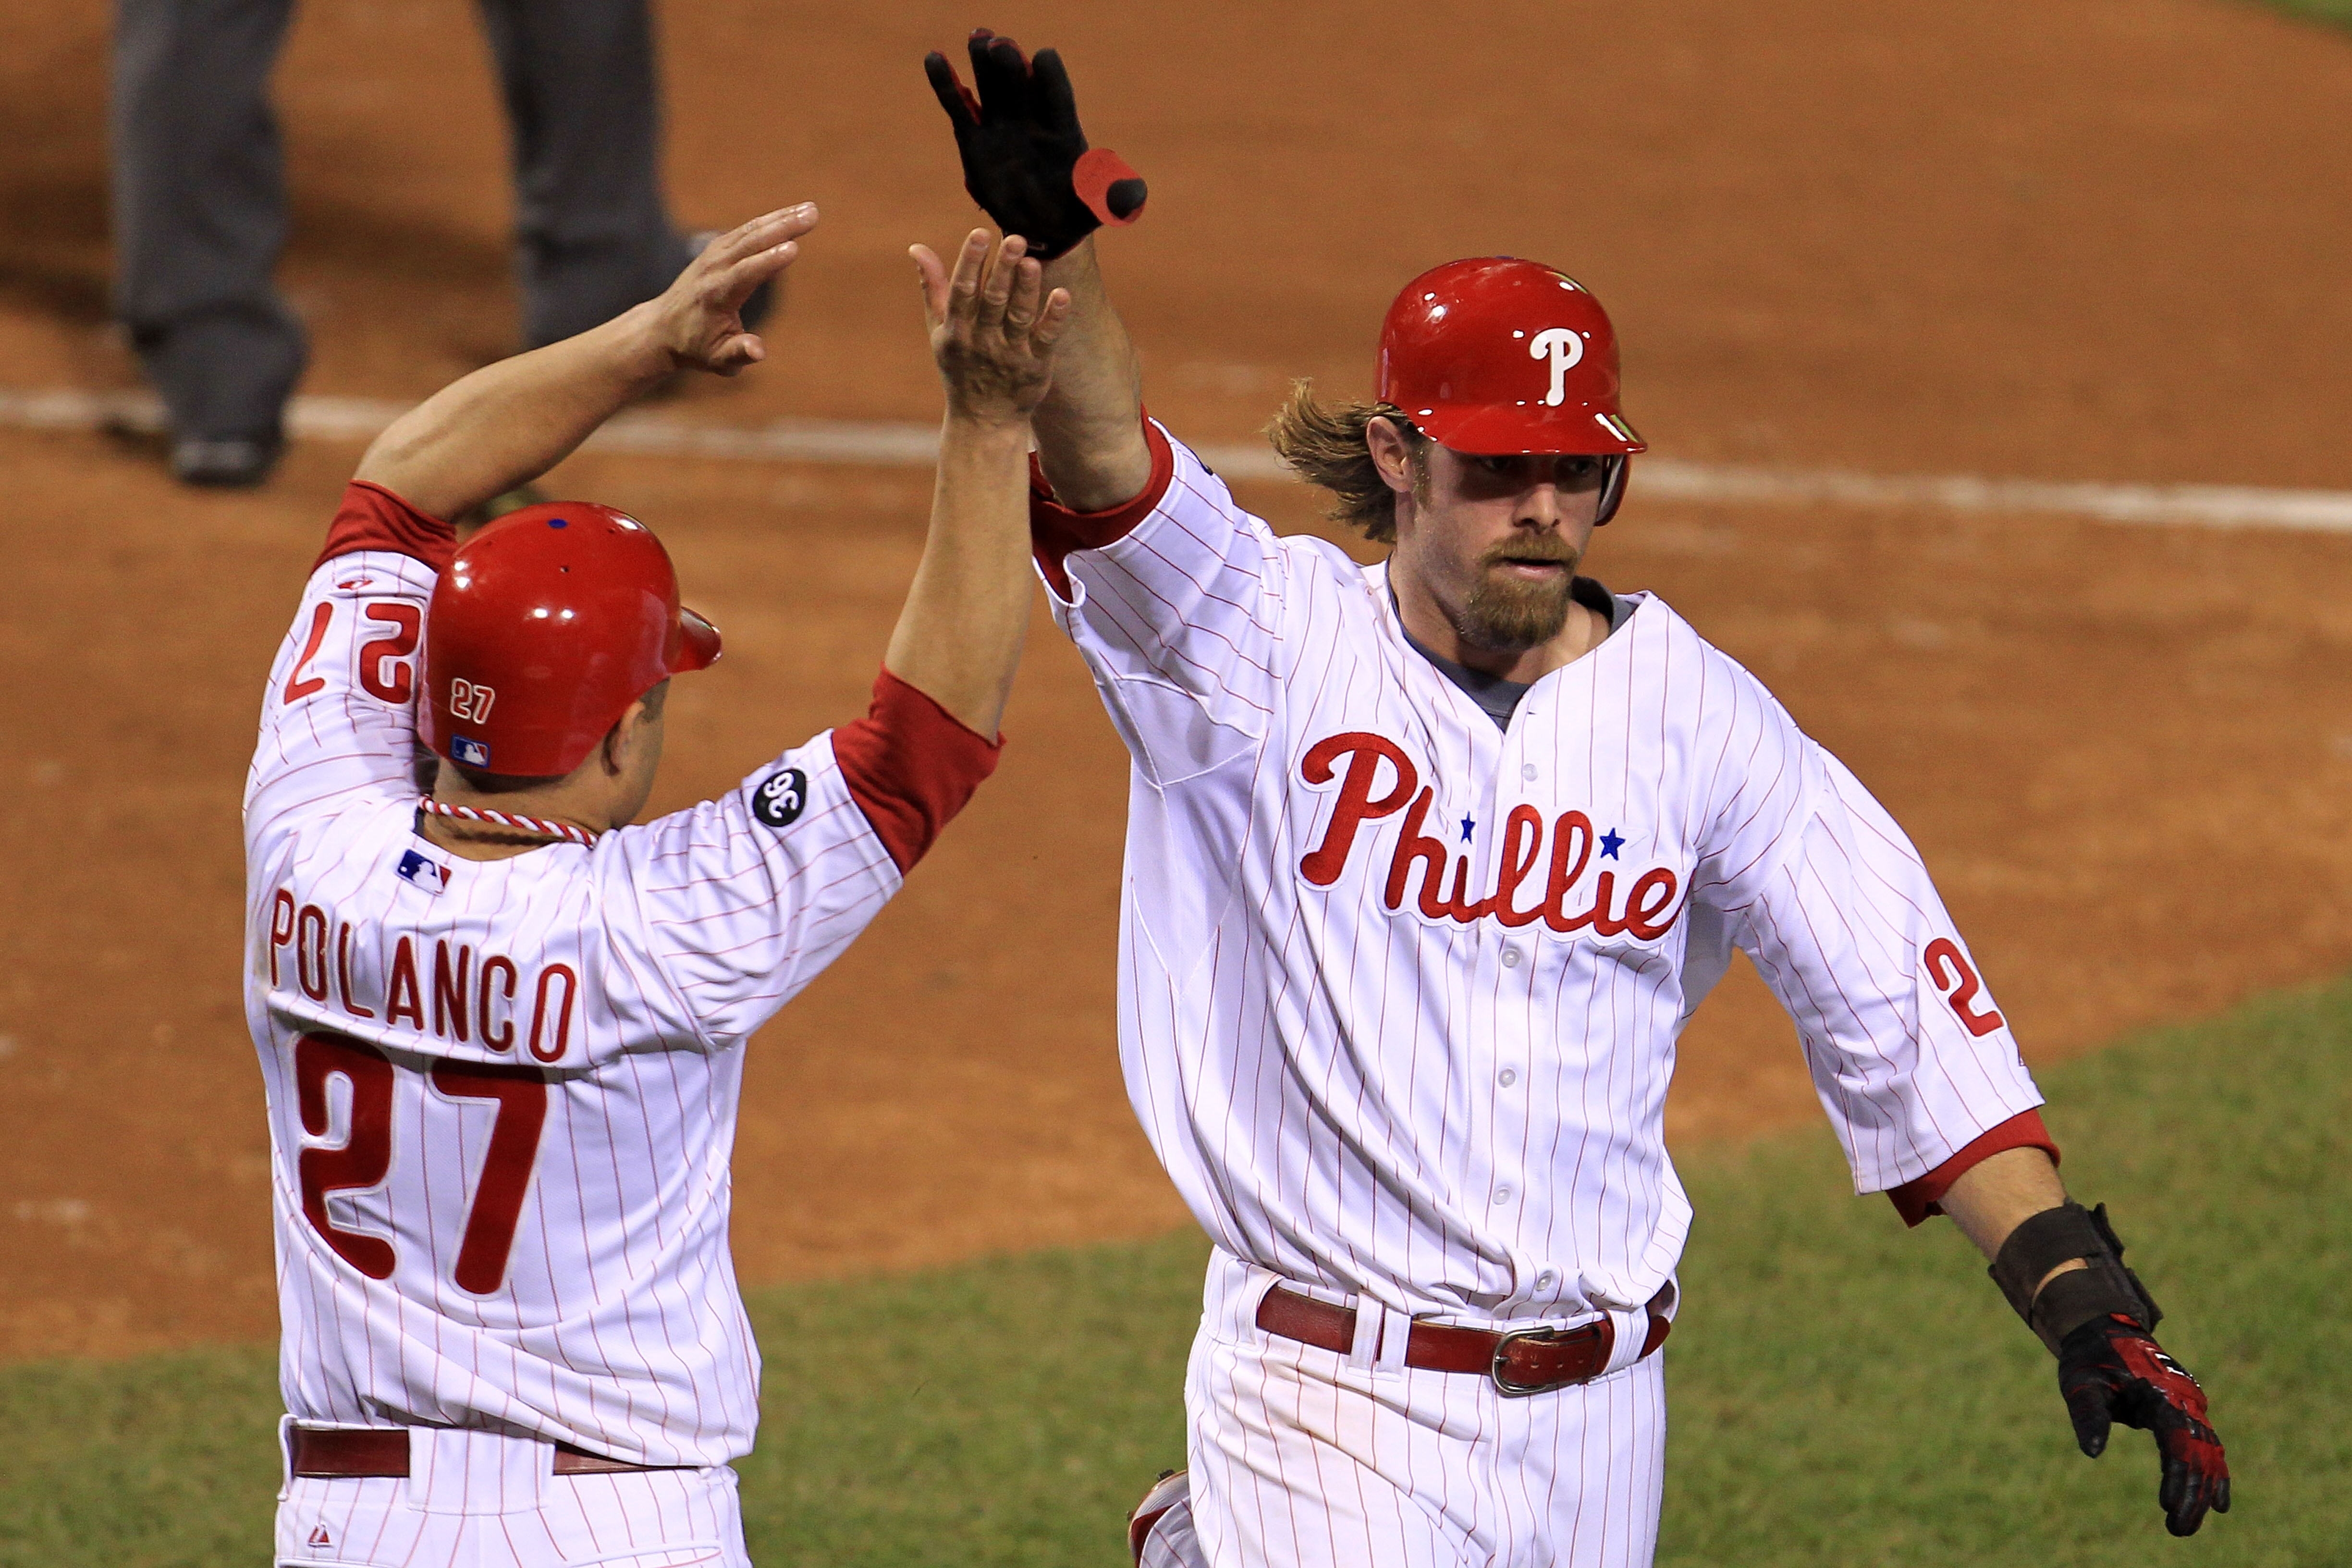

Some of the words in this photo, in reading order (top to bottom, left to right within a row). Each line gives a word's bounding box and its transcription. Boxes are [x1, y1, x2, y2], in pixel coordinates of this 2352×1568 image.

[1529, 327, 1584, 407] P
[283, 600, 421, 706] 27
[450, 677, 496, 725] 27
[763, 772, 799, 819] 36
[1299, 731, 1696, 940] Phillie
[269, 887, 576, 1064] POLANCO
[294, 1030, 549, 1296] 27
